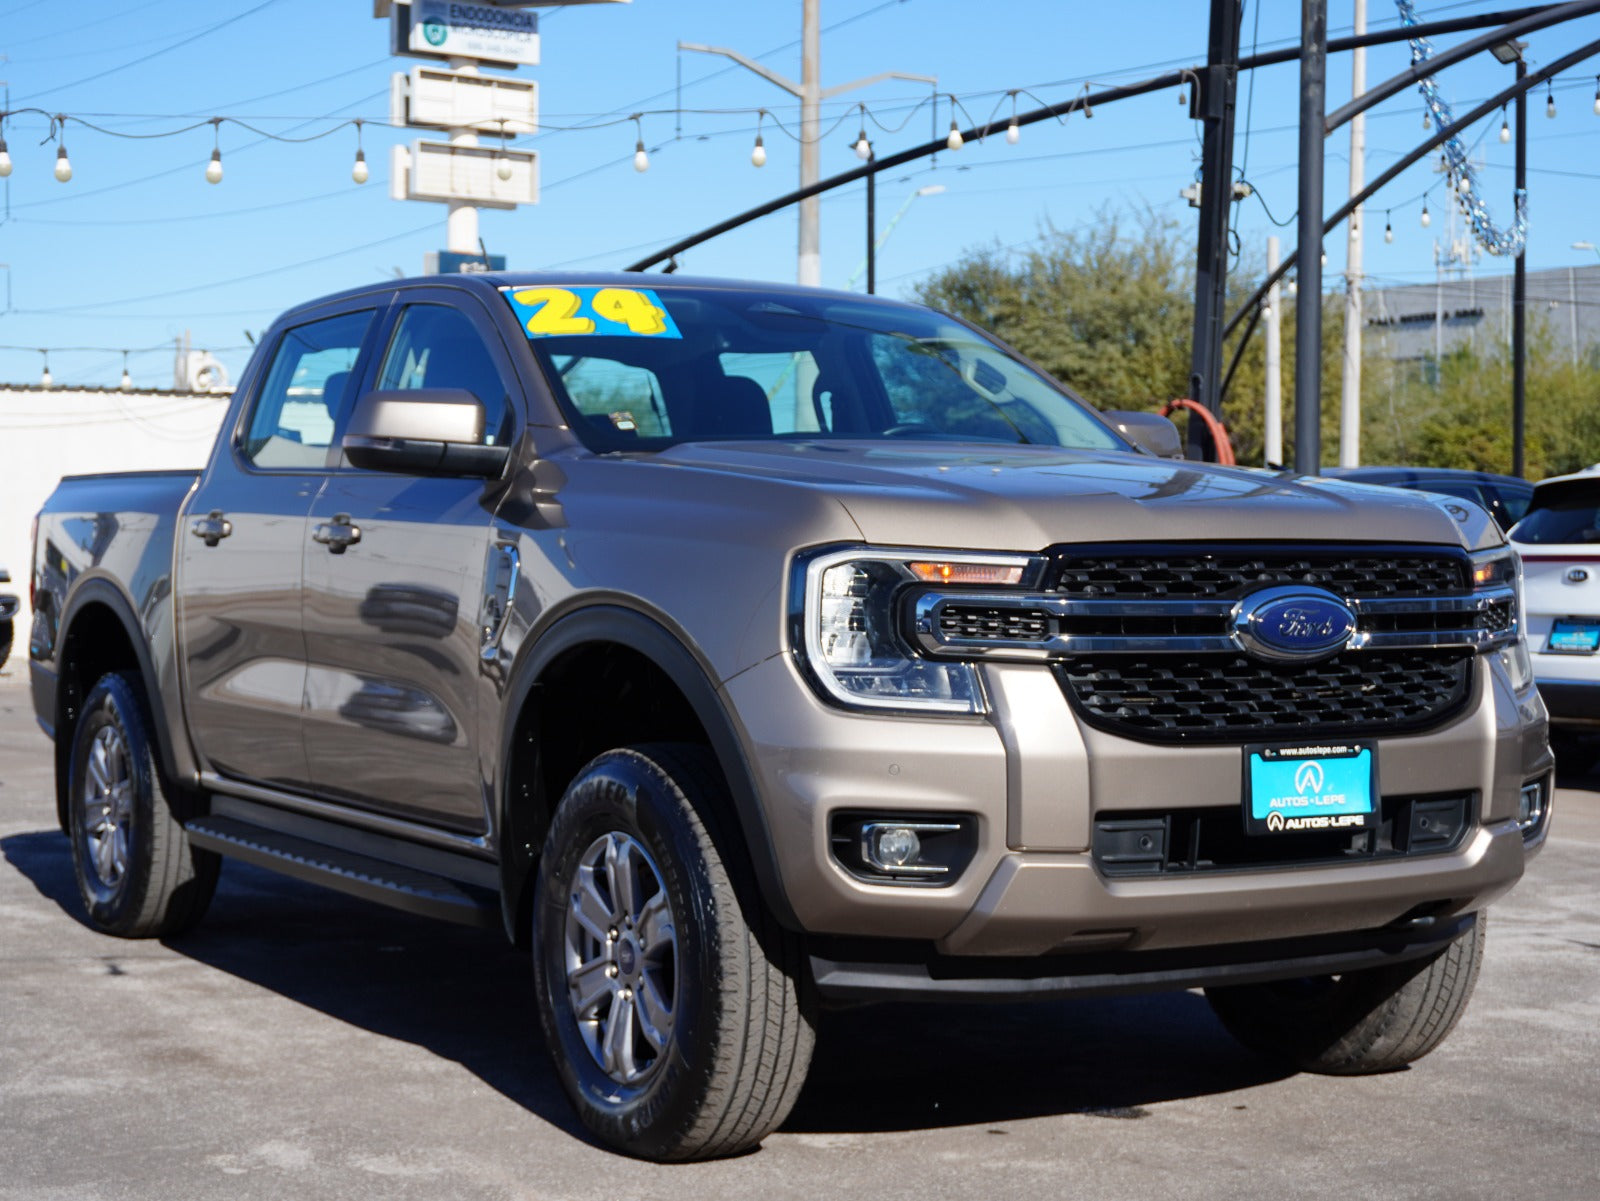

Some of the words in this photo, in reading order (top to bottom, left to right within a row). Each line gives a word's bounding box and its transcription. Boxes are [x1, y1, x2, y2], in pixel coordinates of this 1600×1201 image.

[449, 3, 535, 27] ENDODONCIA
[512, 287, 667, 335] 24
[1280, 608, 1333, 637] Ford
[1279, 745, 1348, 757] www.autoslepe.com
